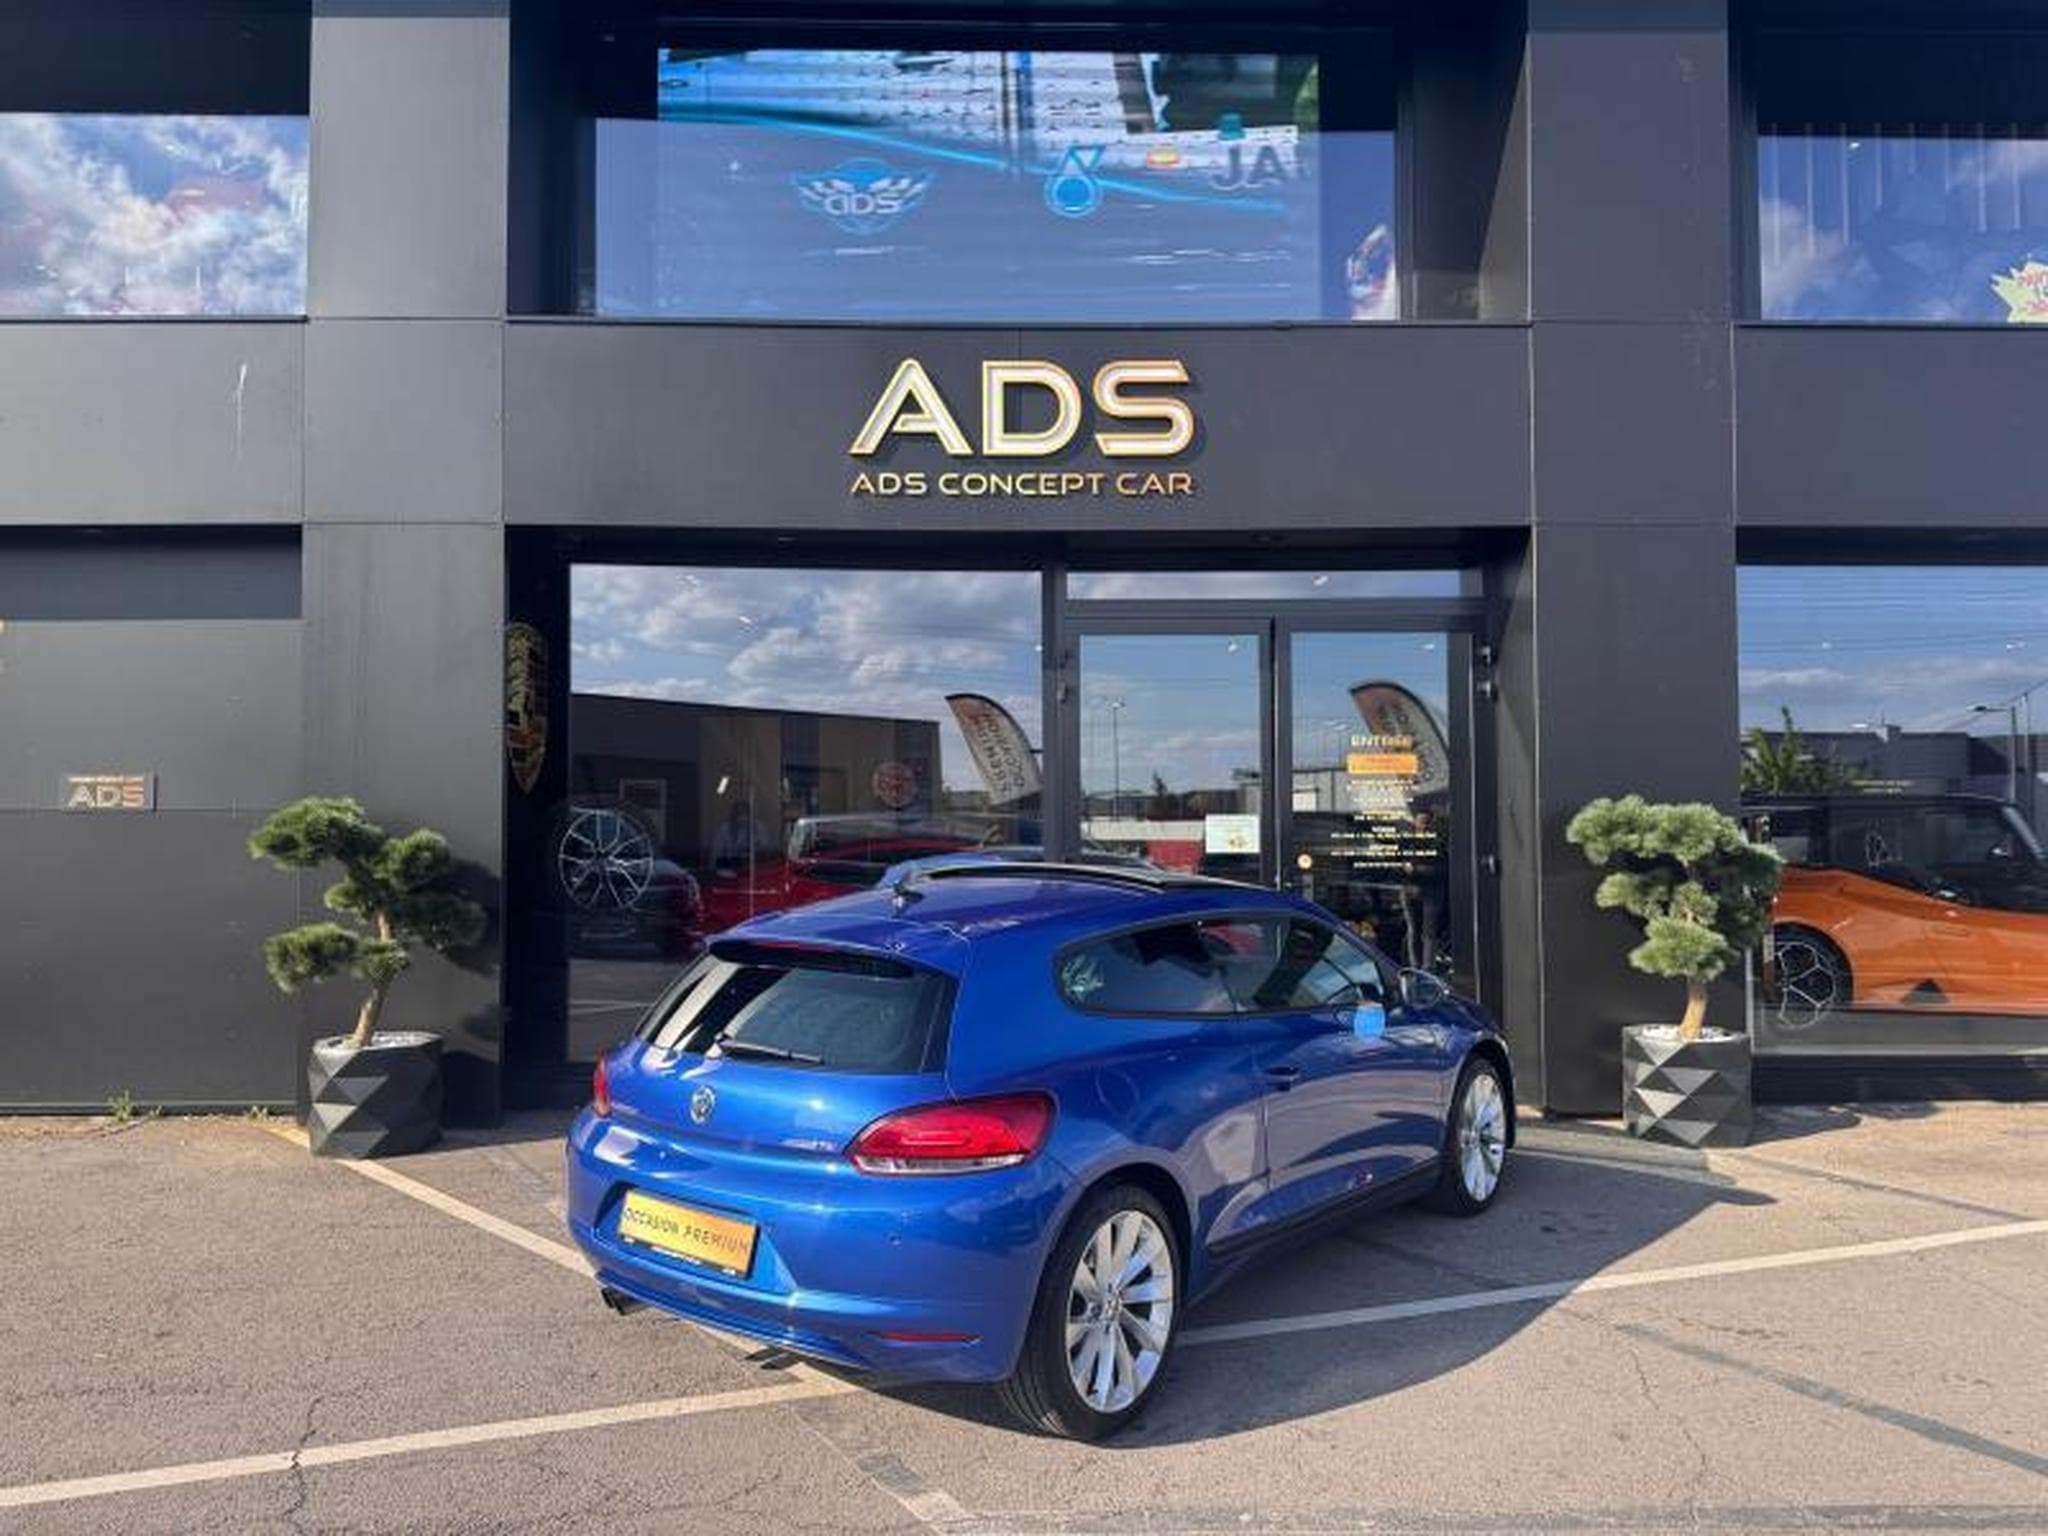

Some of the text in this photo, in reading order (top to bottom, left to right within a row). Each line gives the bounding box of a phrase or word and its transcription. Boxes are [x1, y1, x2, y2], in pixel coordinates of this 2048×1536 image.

[849, 358, 1194, 456] ADS
[851, 473, 1193, 495] ADS CONCEPT CAR
[68, 785, 145, 808] ADS
[624, 1206, 749, 1256] OCCASION PREMIUM
